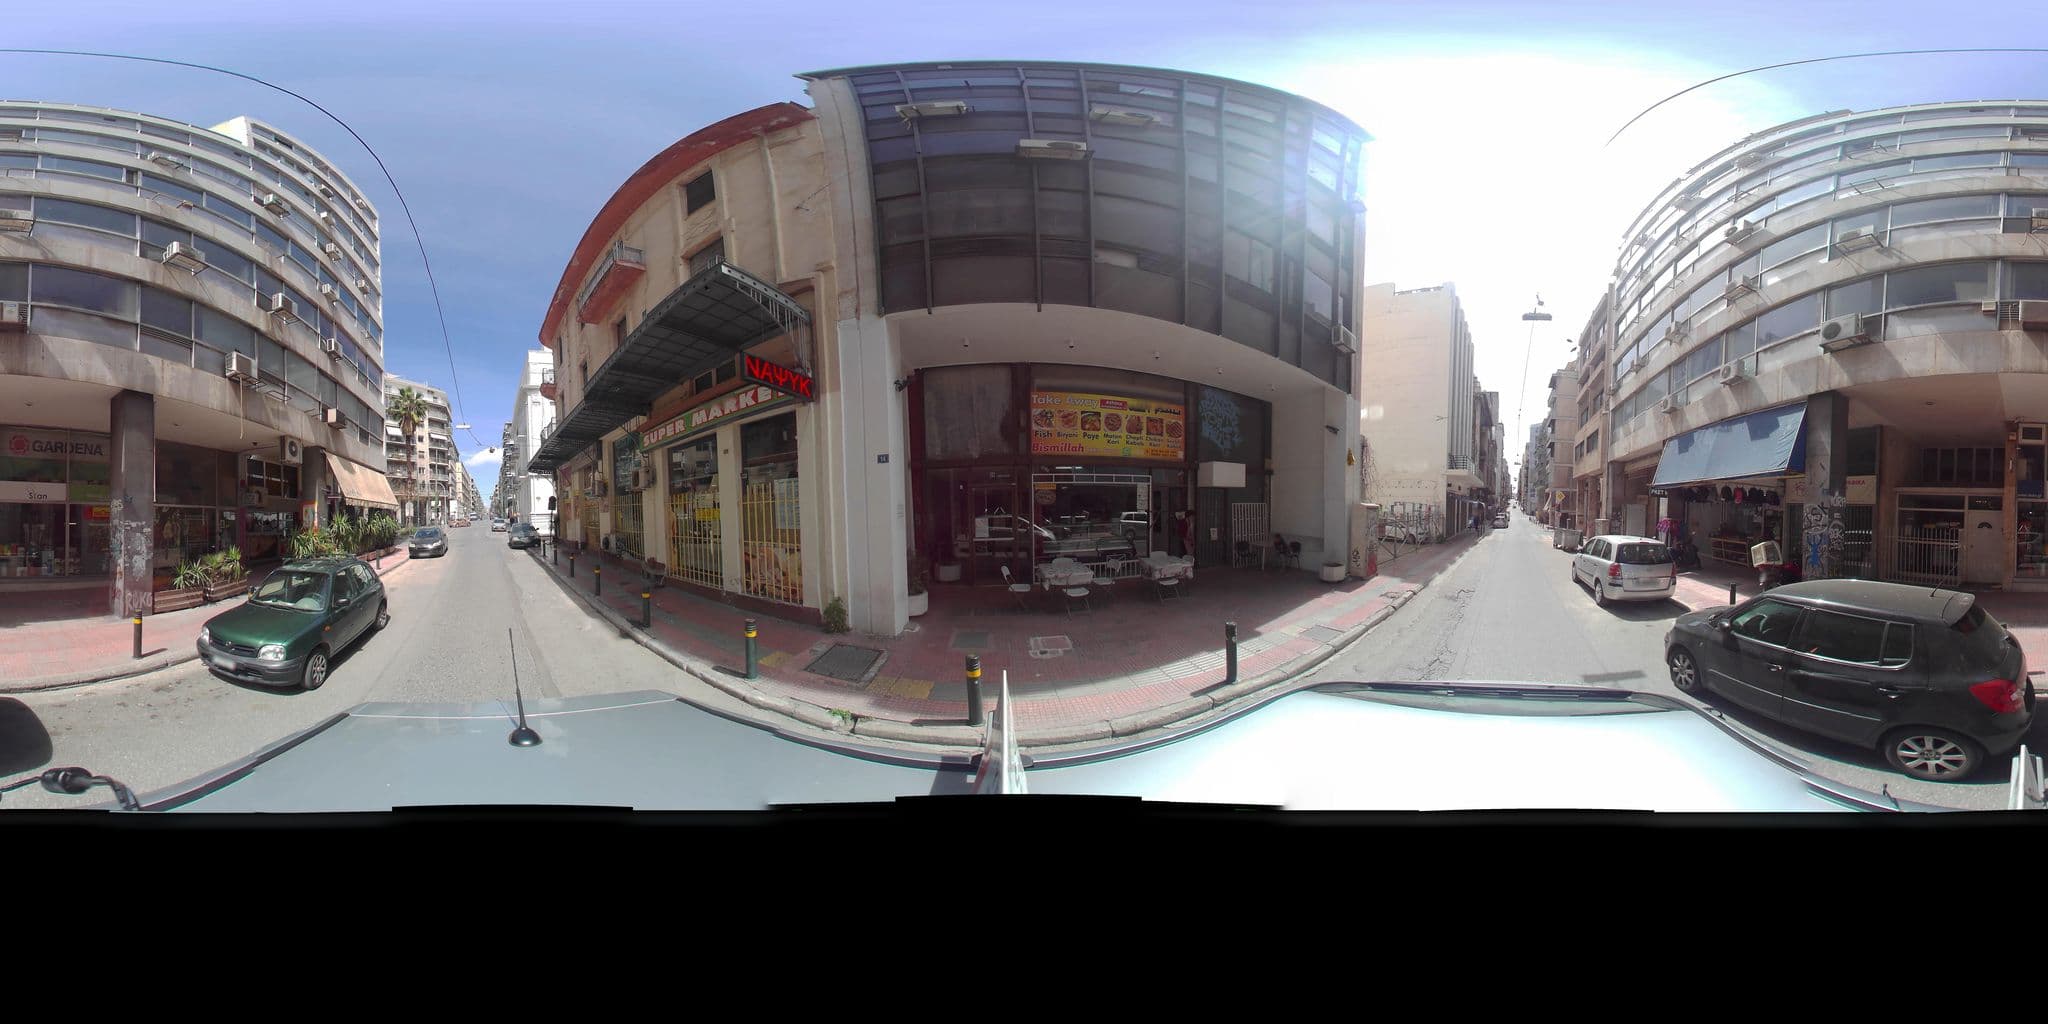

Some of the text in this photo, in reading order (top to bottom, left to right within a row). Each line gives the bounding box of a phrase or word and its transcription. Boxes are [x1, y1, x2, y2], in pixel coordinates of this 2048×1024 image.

[1031, 394, 1062, 406] Take
[1066, 394, 1098, 409] Away
[643, 418, 686, 447] SUPER
[691, 386, 785, 427] MARKE
[1034, 430, 1053, 438] Fish
[32, 440, 104, 456] GARDENA
[1032, 442, 1085, 453] Bismillah
